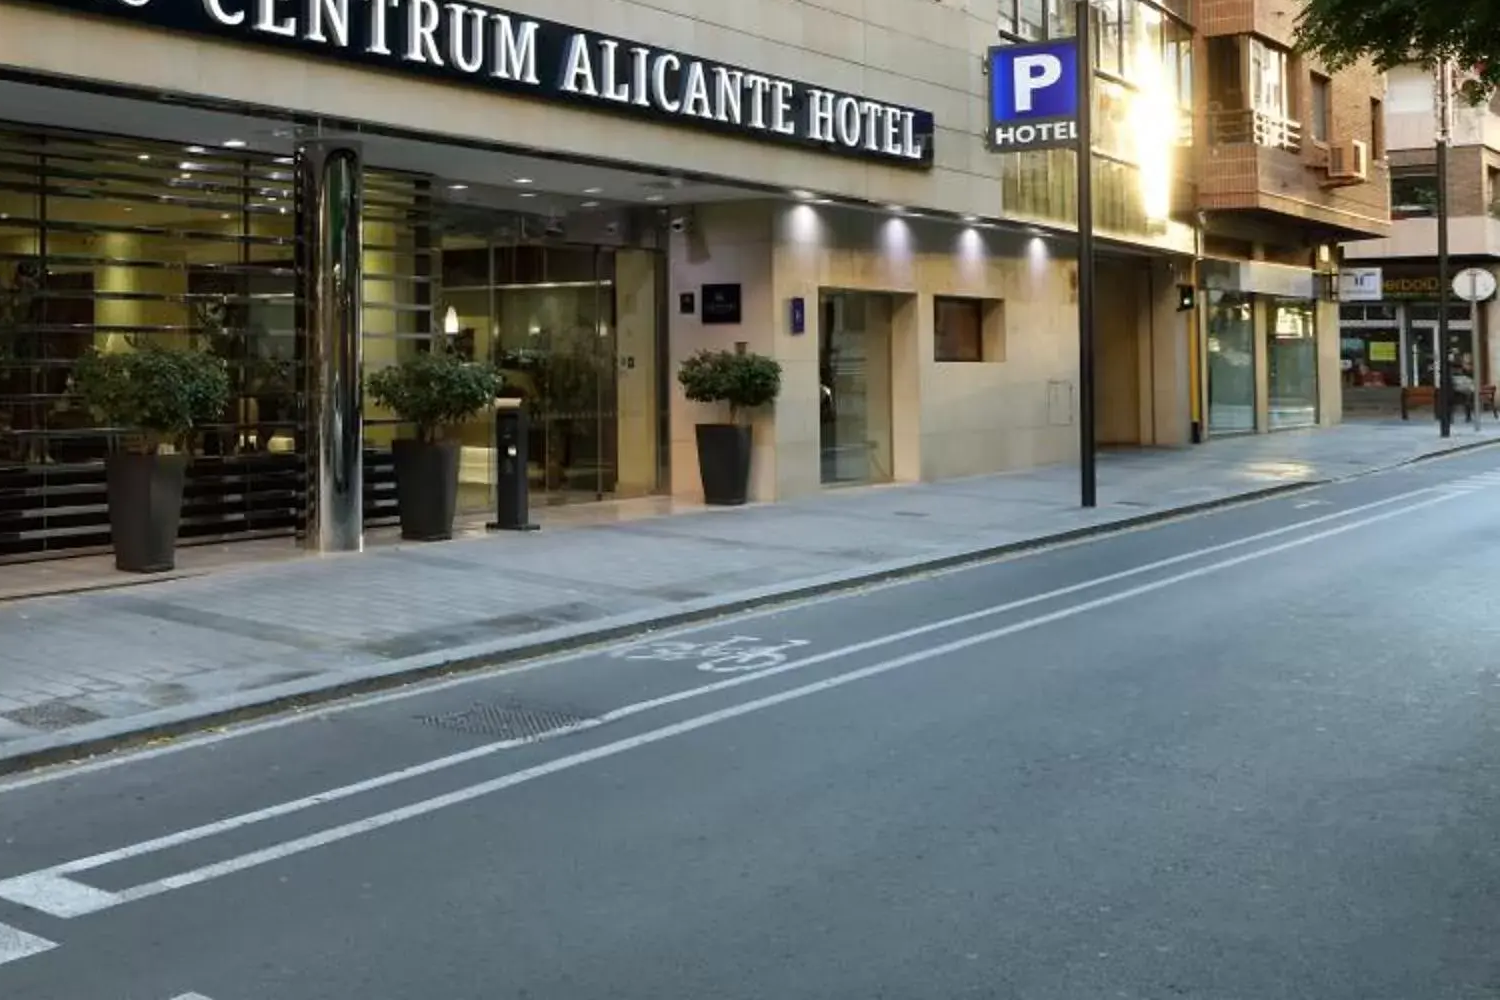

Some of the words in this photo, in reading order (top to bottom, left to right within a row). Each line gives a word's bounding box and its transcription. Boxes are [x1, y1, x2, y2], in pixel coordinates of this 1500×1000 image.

[560, 33, 795, 135] ALICANTE
[806, 88, 922, 159] HOTEL
[1013, 53, 1062, 112] P
[995, 121, 1078, 145] HOTEL
